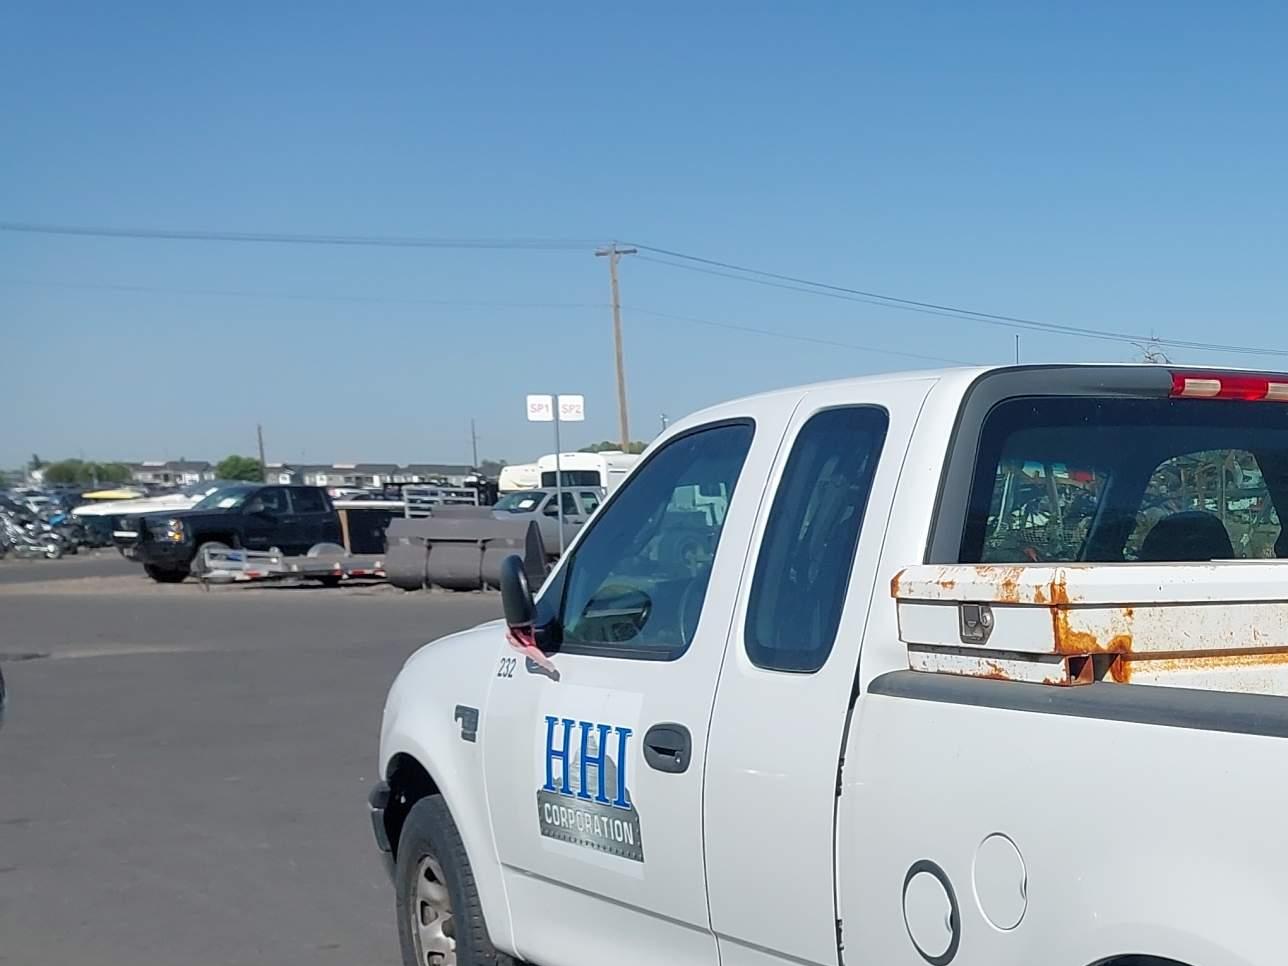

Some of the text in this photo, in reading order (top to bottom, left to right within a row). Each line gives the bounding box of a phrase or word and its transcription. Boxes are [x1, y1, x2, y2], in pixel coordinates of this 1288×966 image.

[529, 403, 550, 414] SP1
[561, 404, 582, 415] SP2
[497, 657, 517, 678] 232
[543, 715, 633, 810] HHI
[543, 803, 634, 845] CORPORATION
